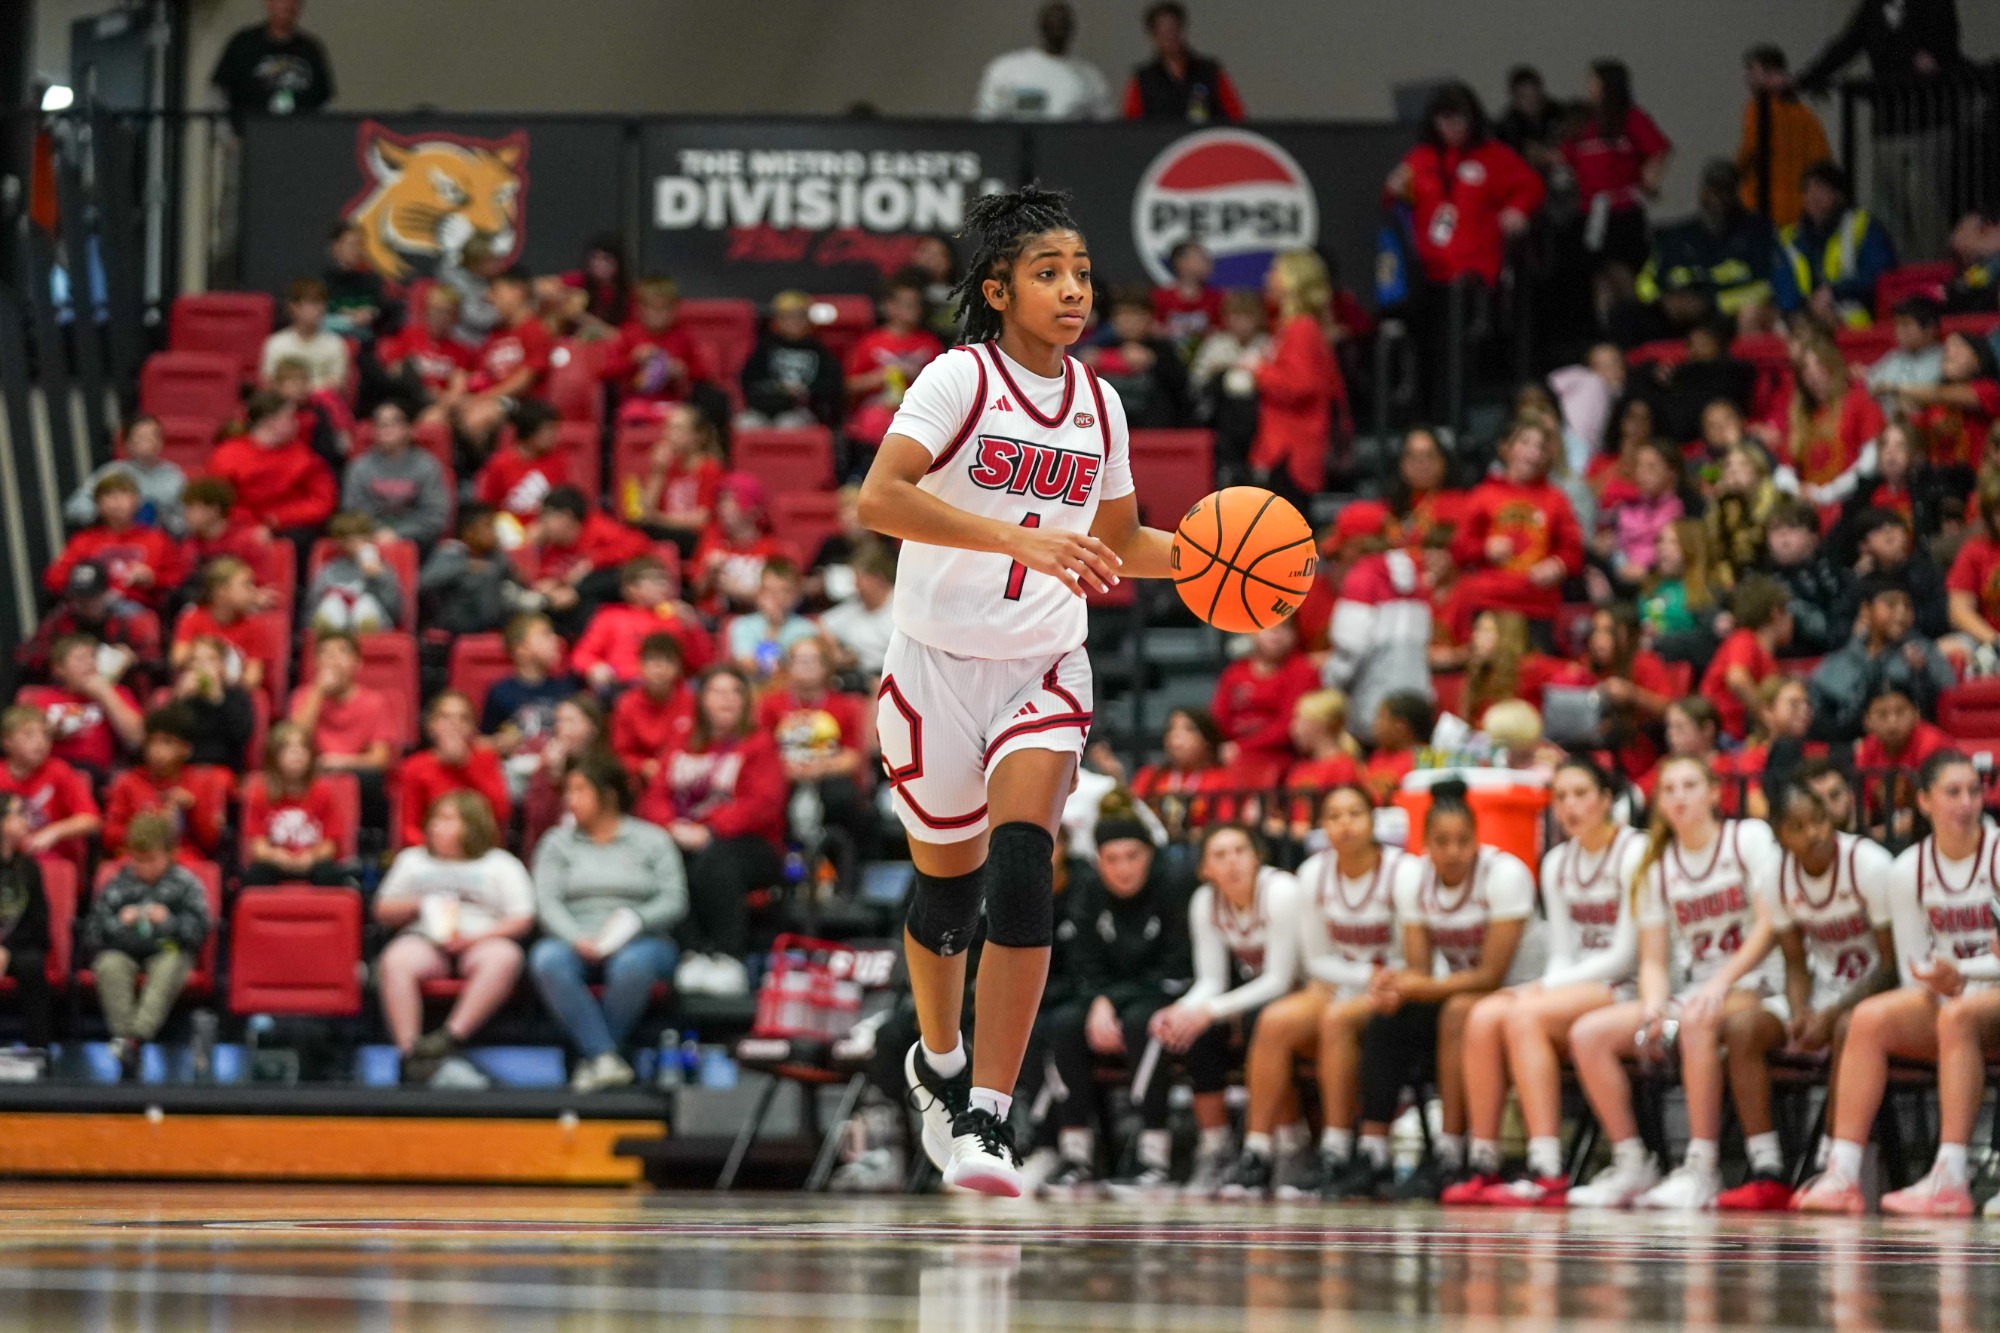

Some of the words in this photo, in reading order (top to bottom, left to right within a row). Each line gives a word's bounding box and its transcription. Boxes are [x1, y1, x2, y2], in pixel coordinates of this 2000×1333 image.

[681, 151, 741, 174] THE
[750, 151, 866, 175] METRO
[655, 176, 966, 231] DIVISION
[1151, 201, 1300, 236] PEPSI
[968, 434, 1101, 507] SIUE
[1674, 884, 1747, 926] SIUE
